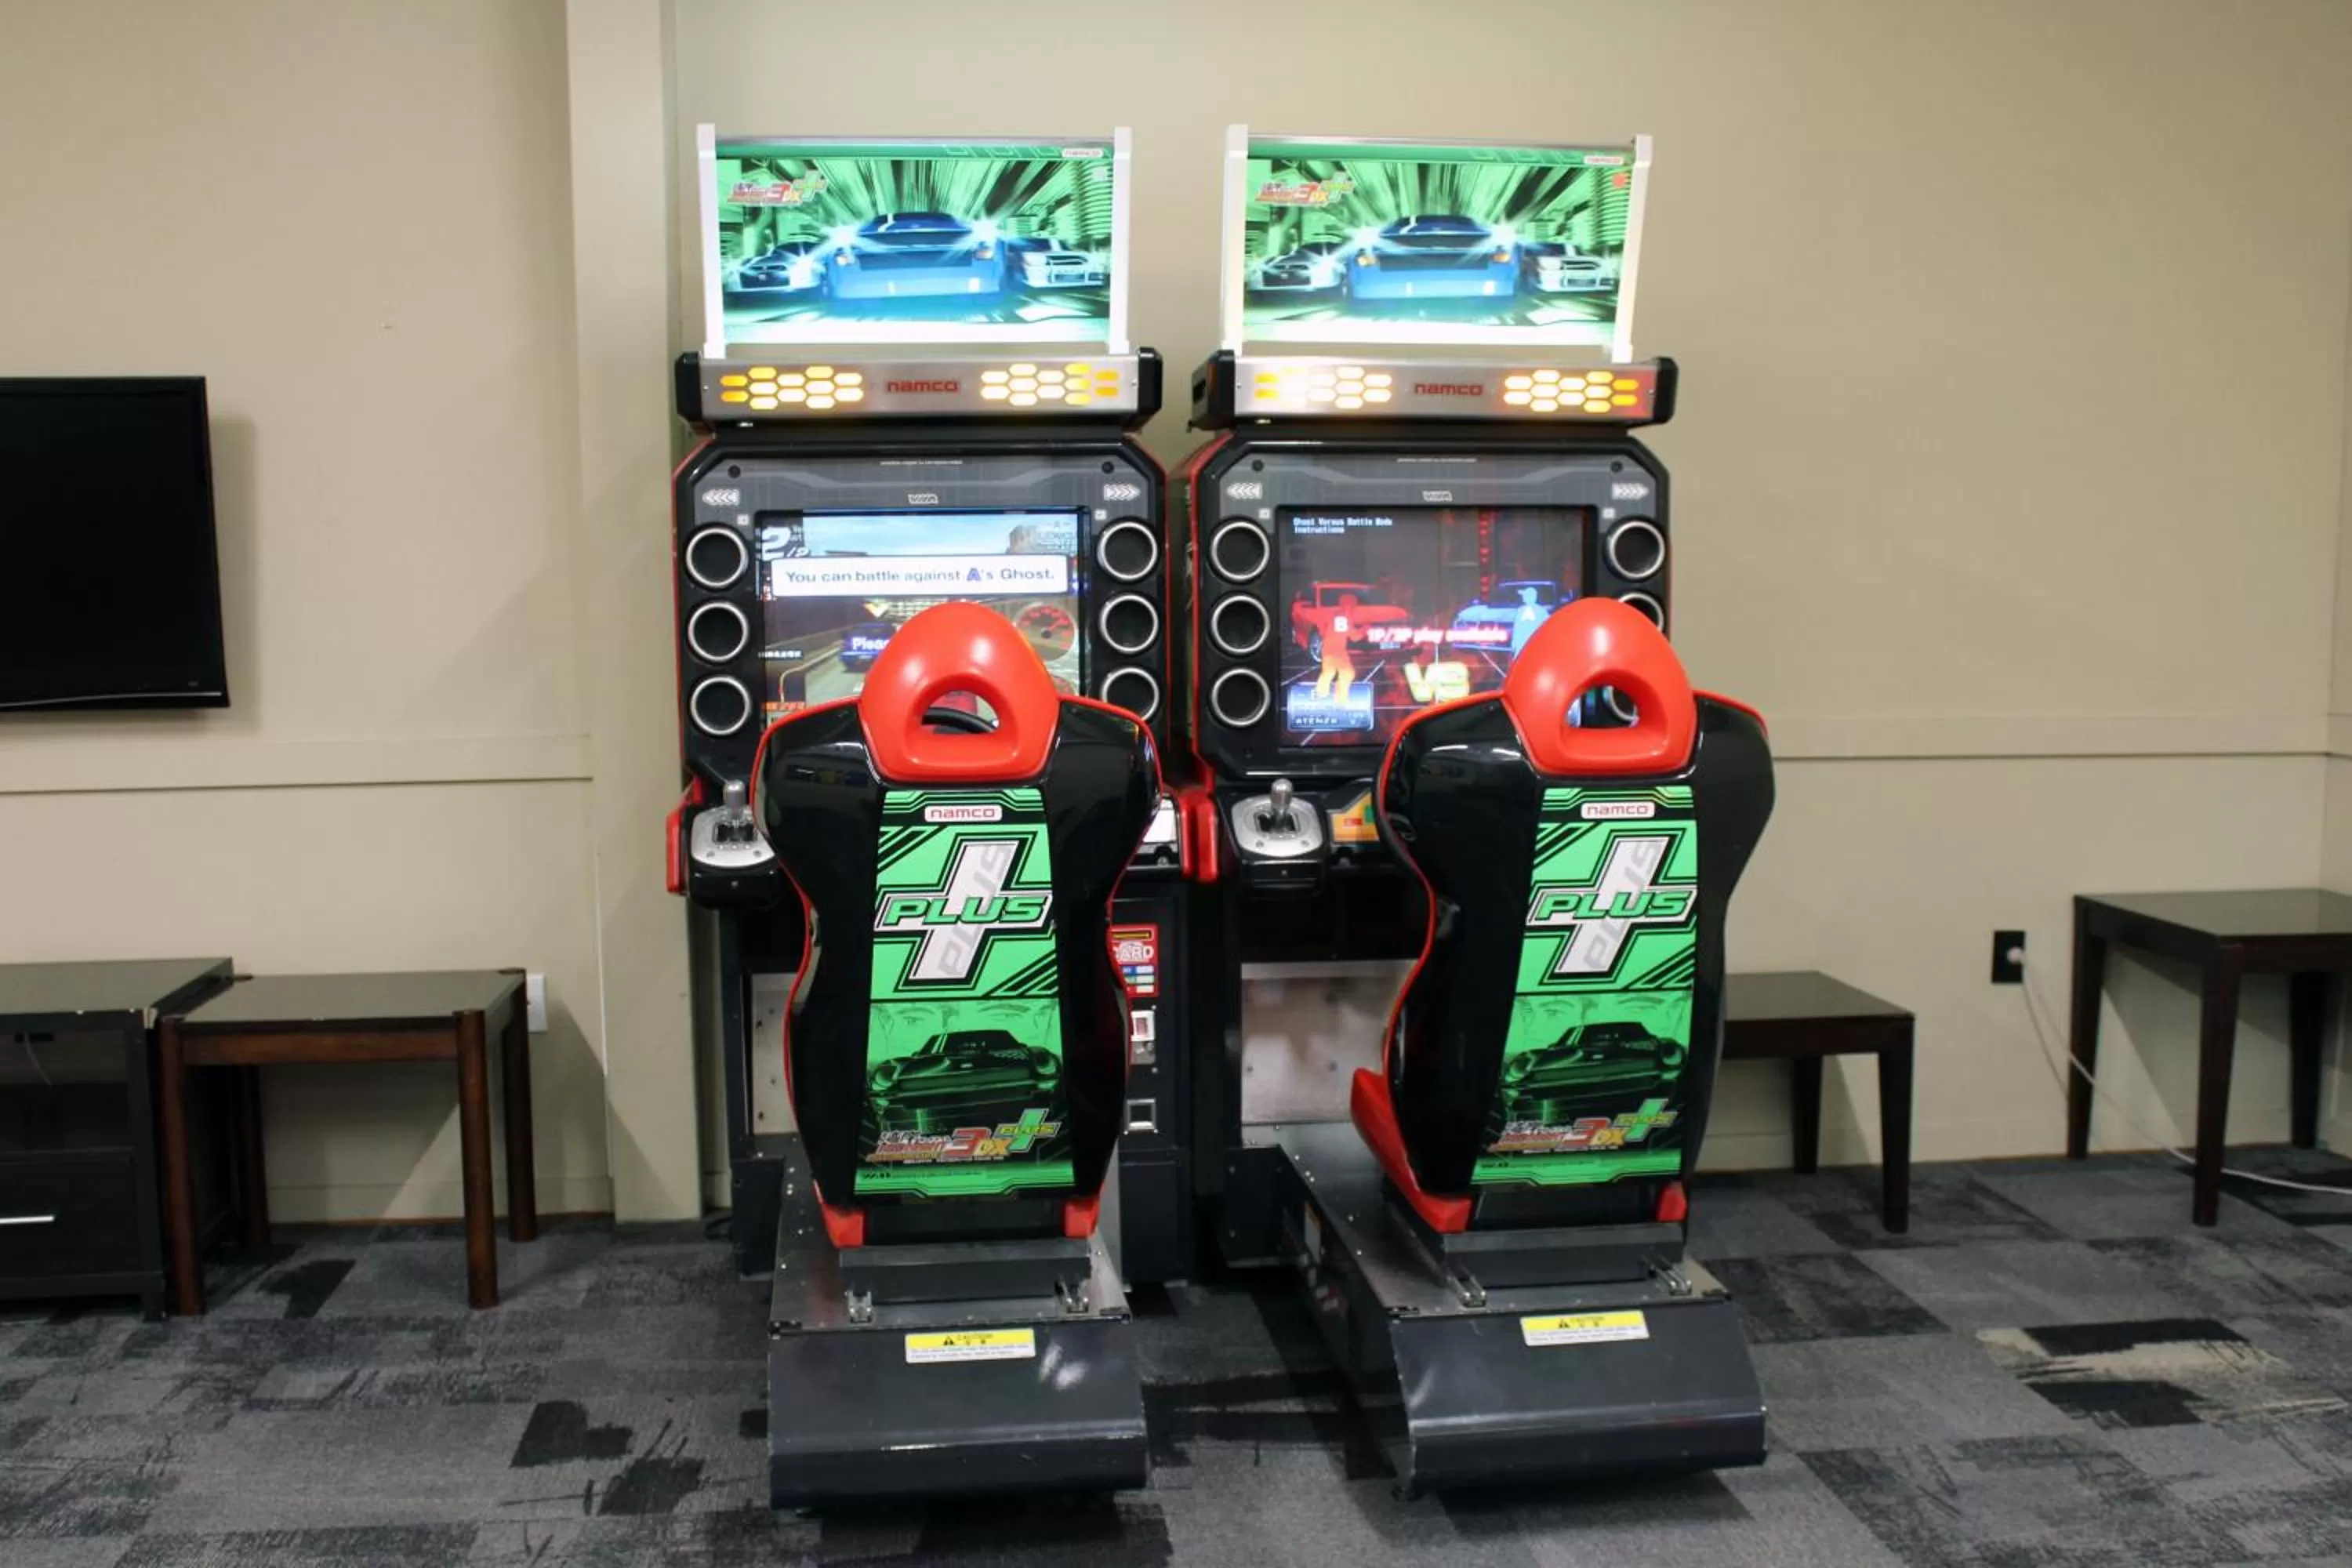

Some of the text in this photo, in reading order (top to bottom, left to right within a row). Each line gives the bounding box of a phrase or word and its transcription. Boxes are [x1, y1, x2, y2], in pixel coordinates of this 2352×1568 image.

[887, 380, 958, 393] namco
[1414, 383, 1483, 396] namco
[786, 571, 816, 583] You
[821, 572, 852, 583] can
[855, 570, 900, 582] battle
[904, 569, 960, 583] against
[1000, 568, 1054, 580] Ghost.
[1521, 606, 1535, 621] A
[1334, 615, 1348, 633] B
[1403, 661, 1470, 702] VS
[931, 808, 996, 818] namco
[1587, 804, 1650, 815] namco
[883, 896, 1045, 927] PLUS
[1535, 891, 1693, 921] PLUS
